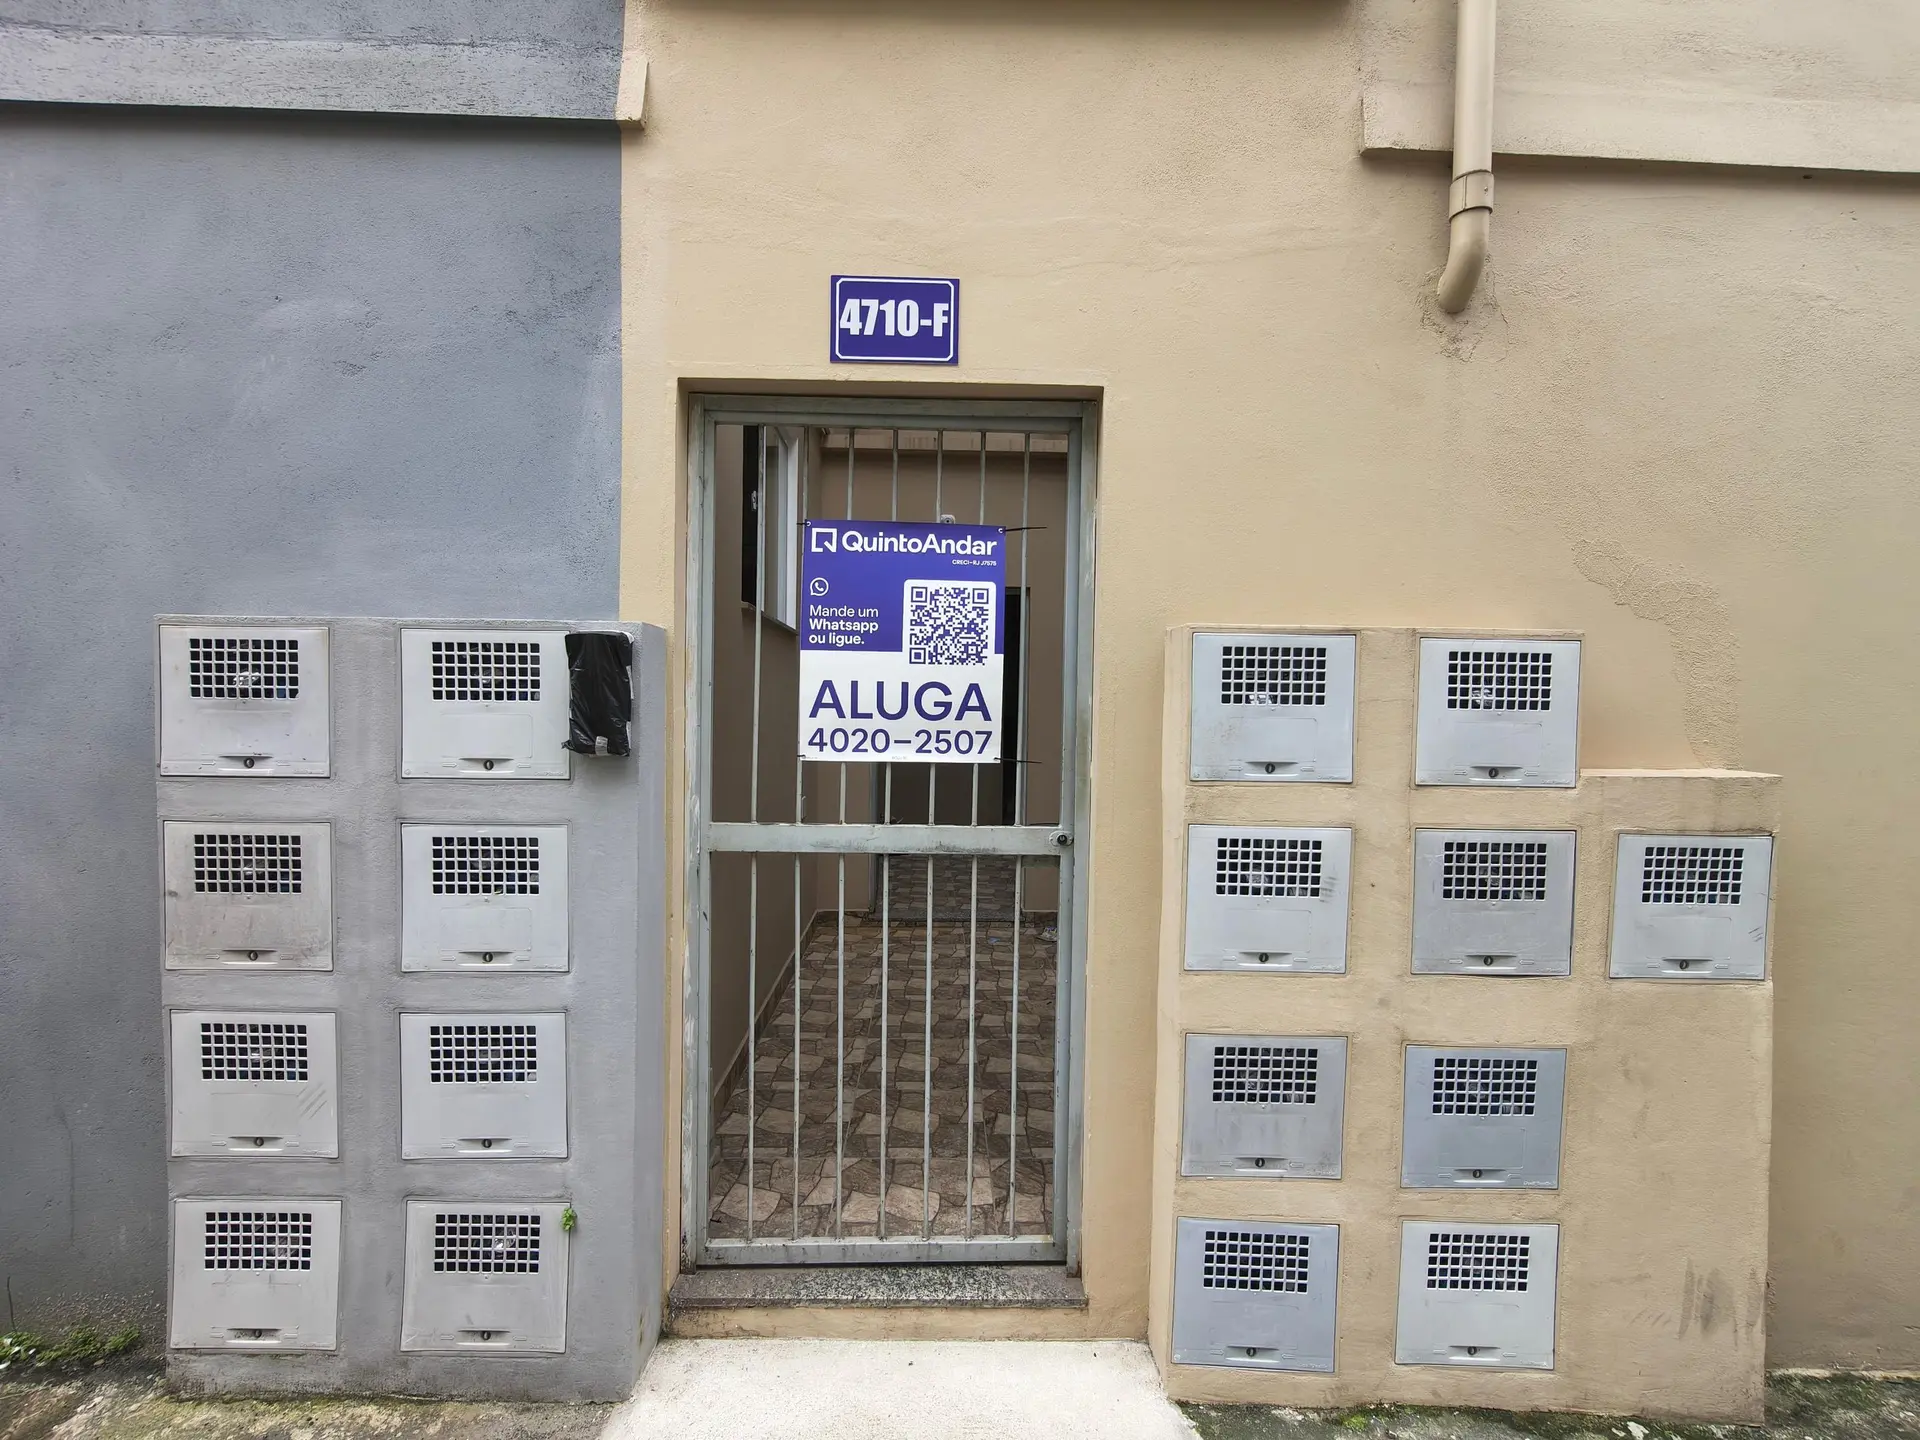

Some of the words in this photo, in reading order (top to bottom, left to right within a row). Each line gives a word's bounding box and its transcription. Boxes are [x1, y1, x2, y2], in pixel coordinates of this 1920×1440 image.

[839, 298, 949, 337] 4710-F
[842, 530, 997, 556] QuintoAndar
[809, 604, 855, 617] Mande
[858, 607, 879, 617] um
[809, 618, 879, 633] Whatsapp
[809, 634, 826, 644] ou
[828, 633, 864, 647] ligue.
[808, 680, 992, 721] ALUGA
[808, 727, 993, 754] 4020-2507
